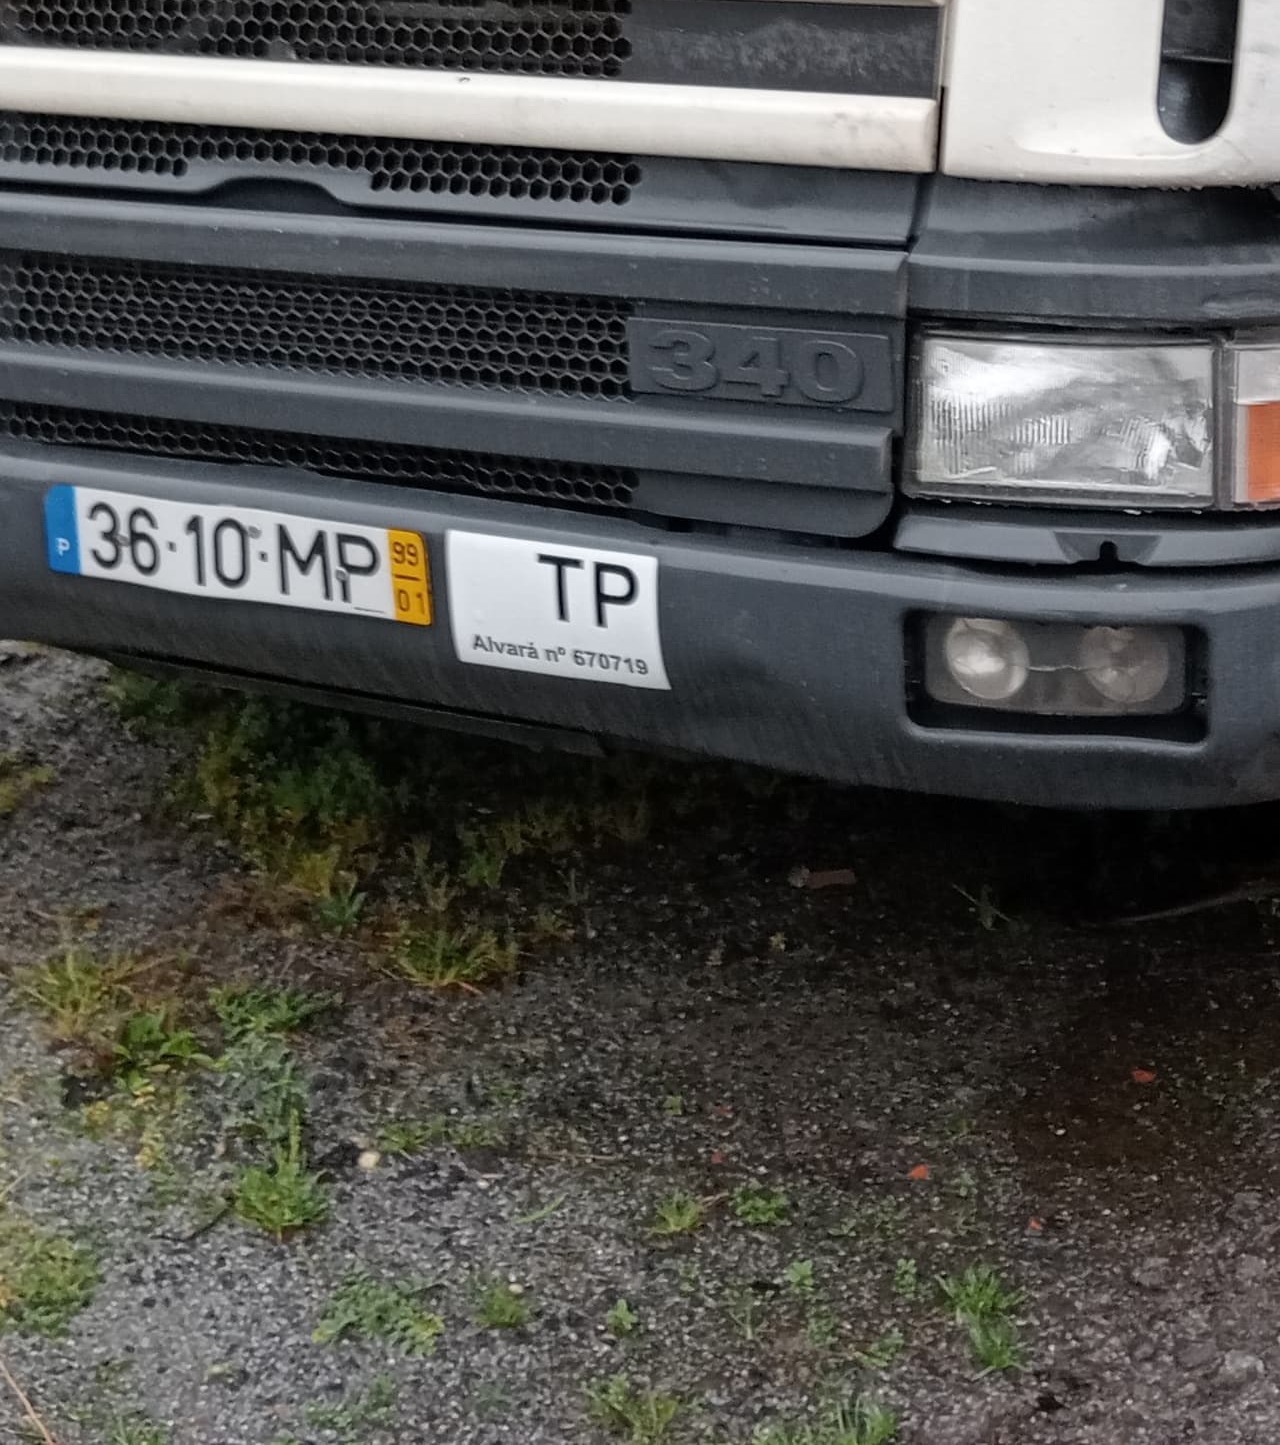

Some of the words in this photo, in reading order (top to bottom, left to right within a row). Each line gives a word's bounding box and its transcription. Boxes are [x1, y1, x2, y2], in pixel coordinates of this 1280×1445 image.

[647, 329, 866, 404] 340
[55, 537, 70, 556] P
[391, 540, 419, 567] 99
[536, 553, 640, 629] TP
[472, 634, 540, 661] Alvará
[572, 649, 650, 677] 670719
